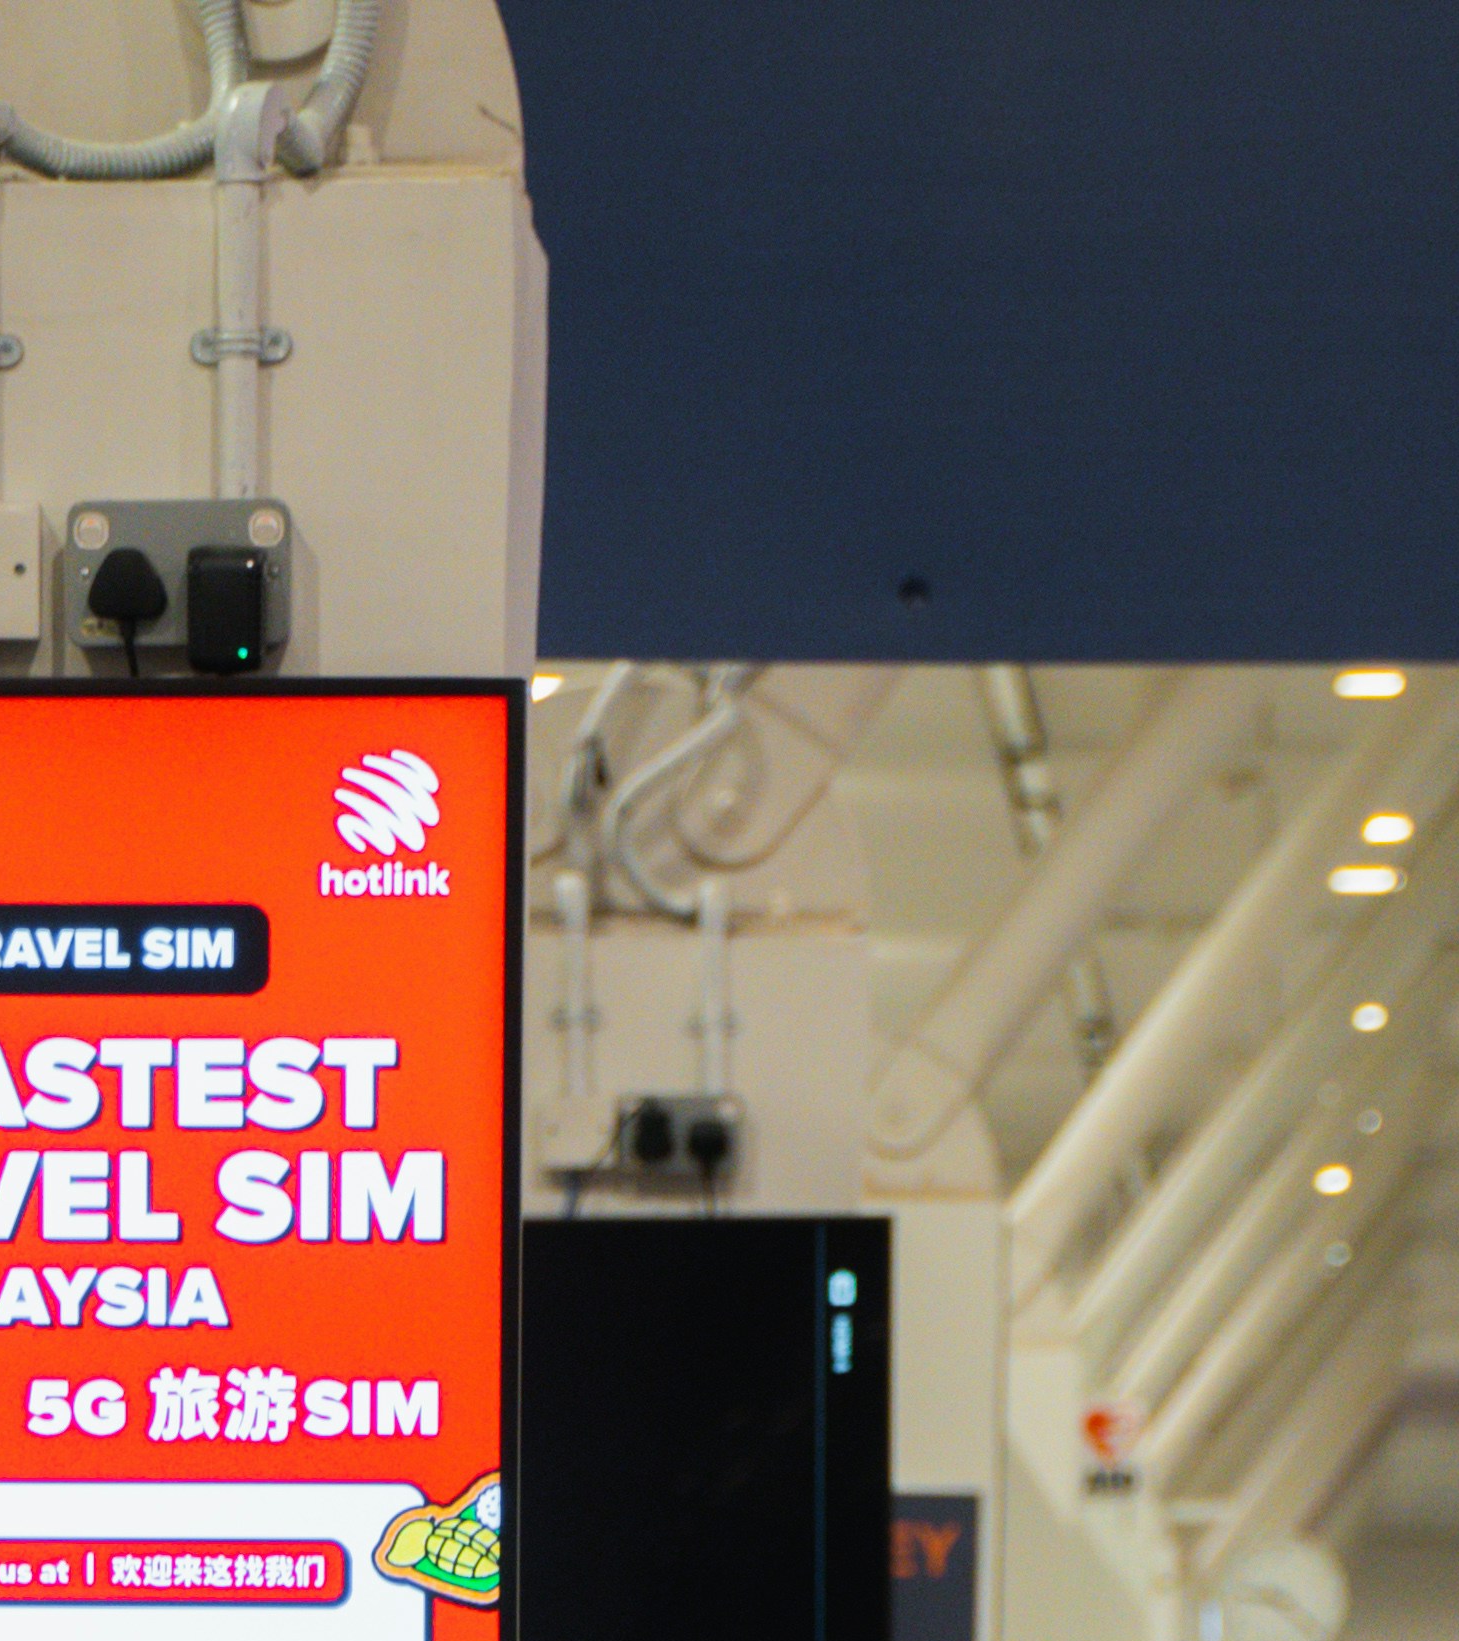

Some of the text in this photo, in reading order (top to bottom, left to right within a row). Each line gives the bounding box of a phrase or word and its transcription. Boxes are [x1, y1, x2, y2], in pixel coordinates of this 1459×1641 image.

[320, 860, 451, 897] hotlink
[141, 926, 236, 971] SIM
[215, 1150, 444, 1243] SIM
[27, 1378, 127, 1436] 5G
[38, 1559, 71, 1585] at
[111, 1553, 326, 1588] 欢迎来这找我们
